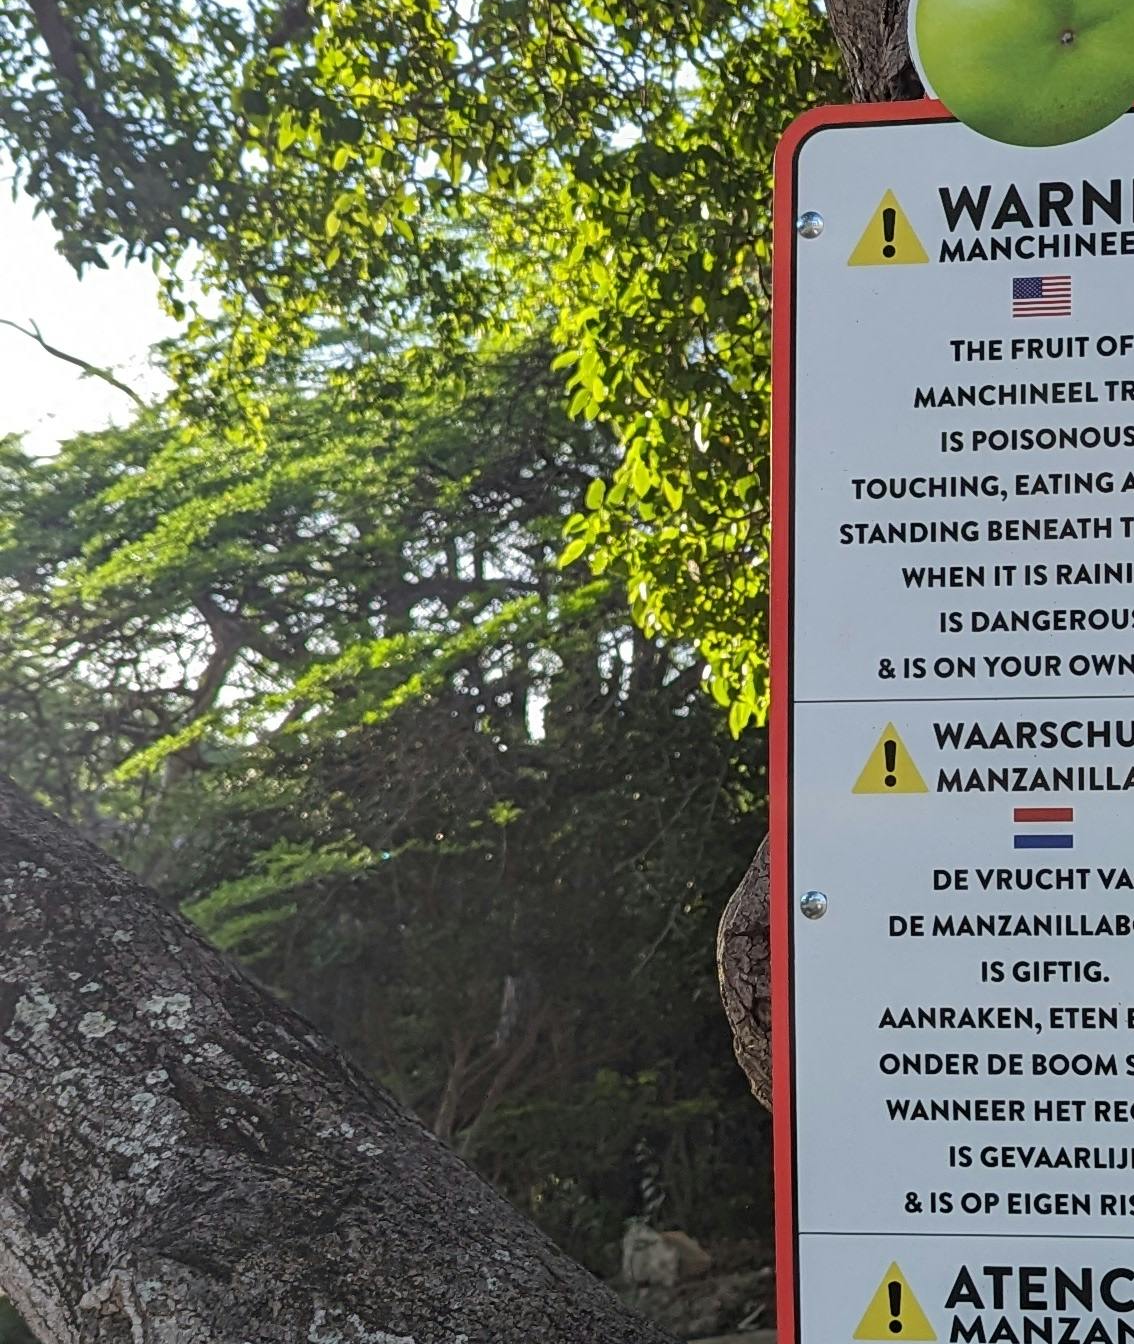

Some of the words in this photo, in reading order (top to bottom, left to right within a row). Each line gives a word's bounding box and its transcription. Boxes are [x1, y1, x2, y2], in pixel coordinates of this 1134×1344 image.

[949, 339, 1003, 362] THE
[1011, 336, 1090, 360] FRUIT
[1096, 334, 1134, 357] OF
[913, 381, 1099, 409] MANCHINEEL
[941, 430, 964, 453] IS
[851, 475, 1008, 502] TOUCHING,
[1015, 471, 1114, 496] EATING
[839, 520, 979, 545] STANDING
[987, 517, 1112, 542] BENEATH
[901, 565, 985, 589] WHEN
[994, 565, 1017, 587] IT
[1024, 564, 1048, 586] IS
[940, 611, 964, 633] IS
[878, 658, 897, 680] &
[903, 657, 927, 679] IS
[933, 656, 976, 679] ON
[982, 655, 1062, 678] YOUR
[933, 869, 969, 891] DE
[975, 868, 1091, 891] VRUCHT
[889, 915, 925, 937] DE
[981, 960, 1005, 983] IS
[1012, 960, 1110, 983] GIFTIG.
[878, 1006, 1043, 1035] AANRAKEN,
[1049, 1007, 1118, 1030] ETEN
[879, 1053, 979, 1076] ONDER
[987, 1053, 1024, 1076] DE
[1031, 1053, 1118, 1076] BOOM
[885, 1099, 1026, 1122] WANNEER
[1034, 1100, 1087, 1122] HET
[949, 1145, 973, 1168] IS
[904, 1191, 923, 1214] &
[930, 1191, 954, 1214] IS
[960, 1192, 1000, 1214] OP
[1007, 1192, 1091, 1216] EIGEN
